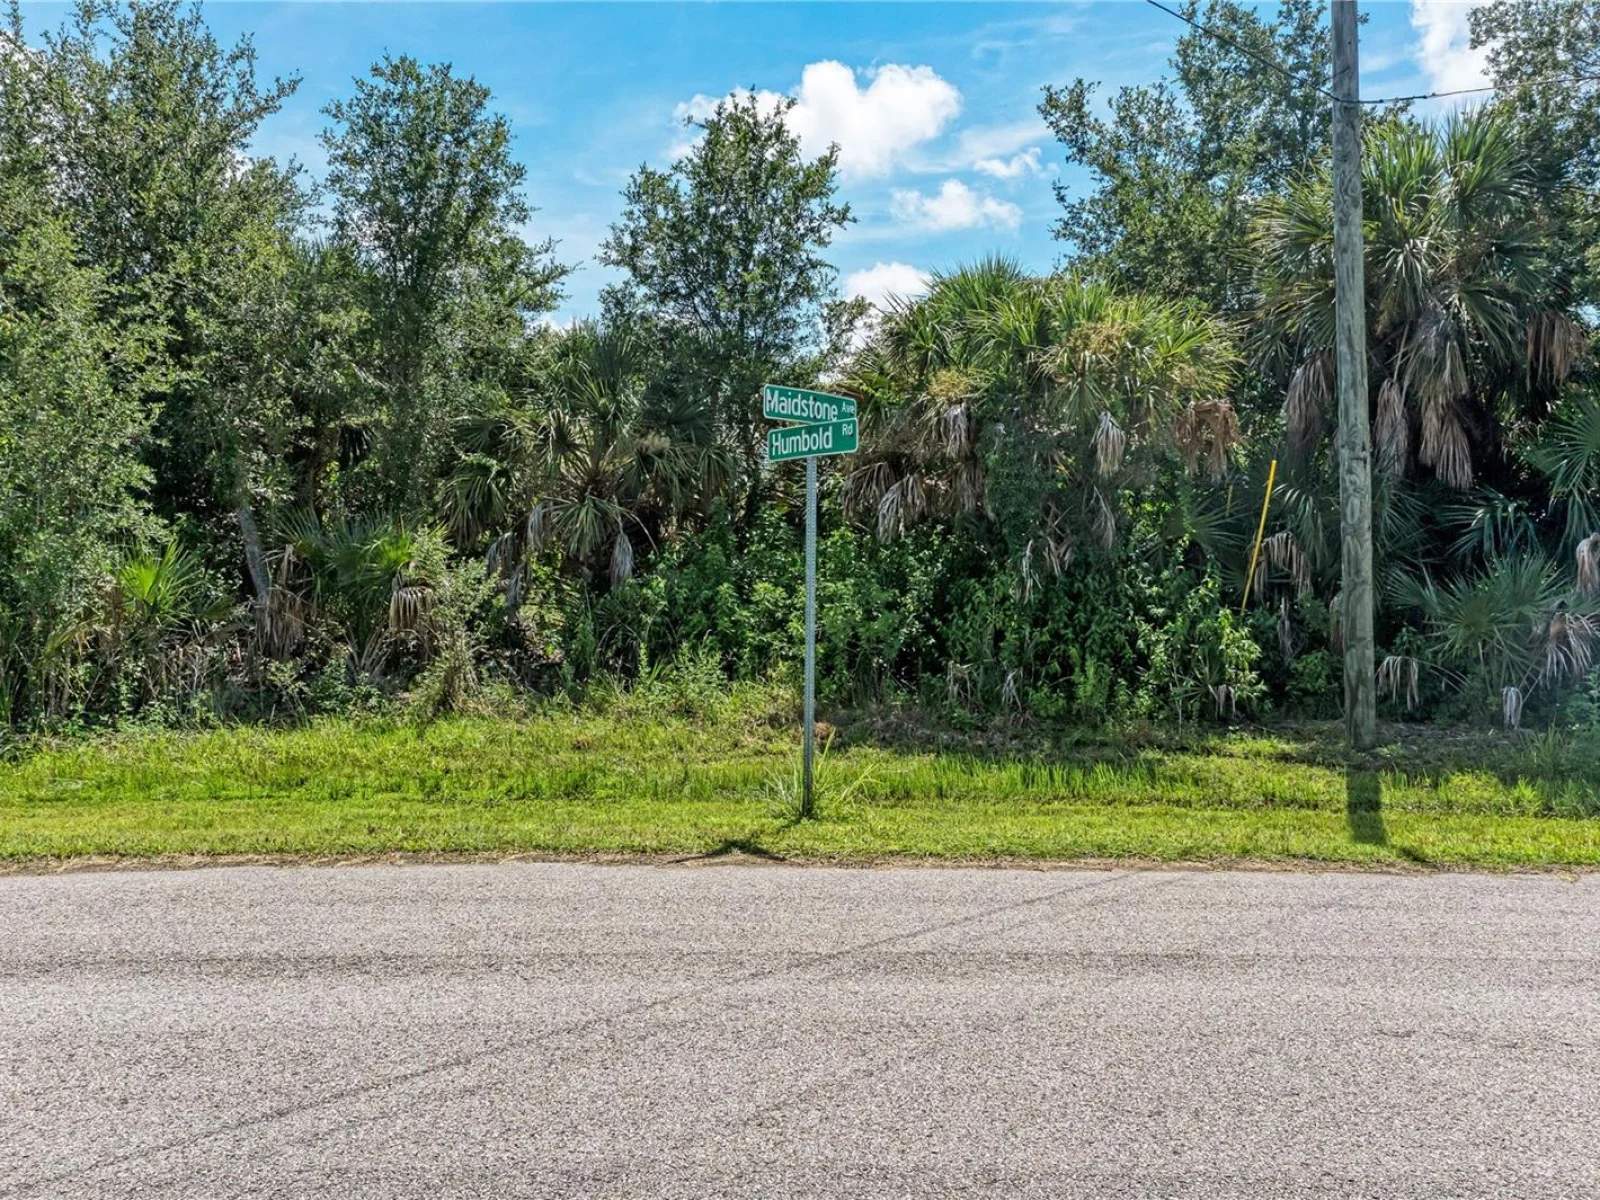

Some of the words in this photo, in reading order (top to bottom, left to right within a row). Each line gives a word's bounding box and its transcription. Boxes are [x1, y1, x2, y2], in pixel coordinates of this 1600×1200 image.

[766, 389, 838, 421] Maidstone
[841, 401, 855, 414] Ave
[772, 426, 833, 456] Humbold
[842, 423, 853, 436] Rd
